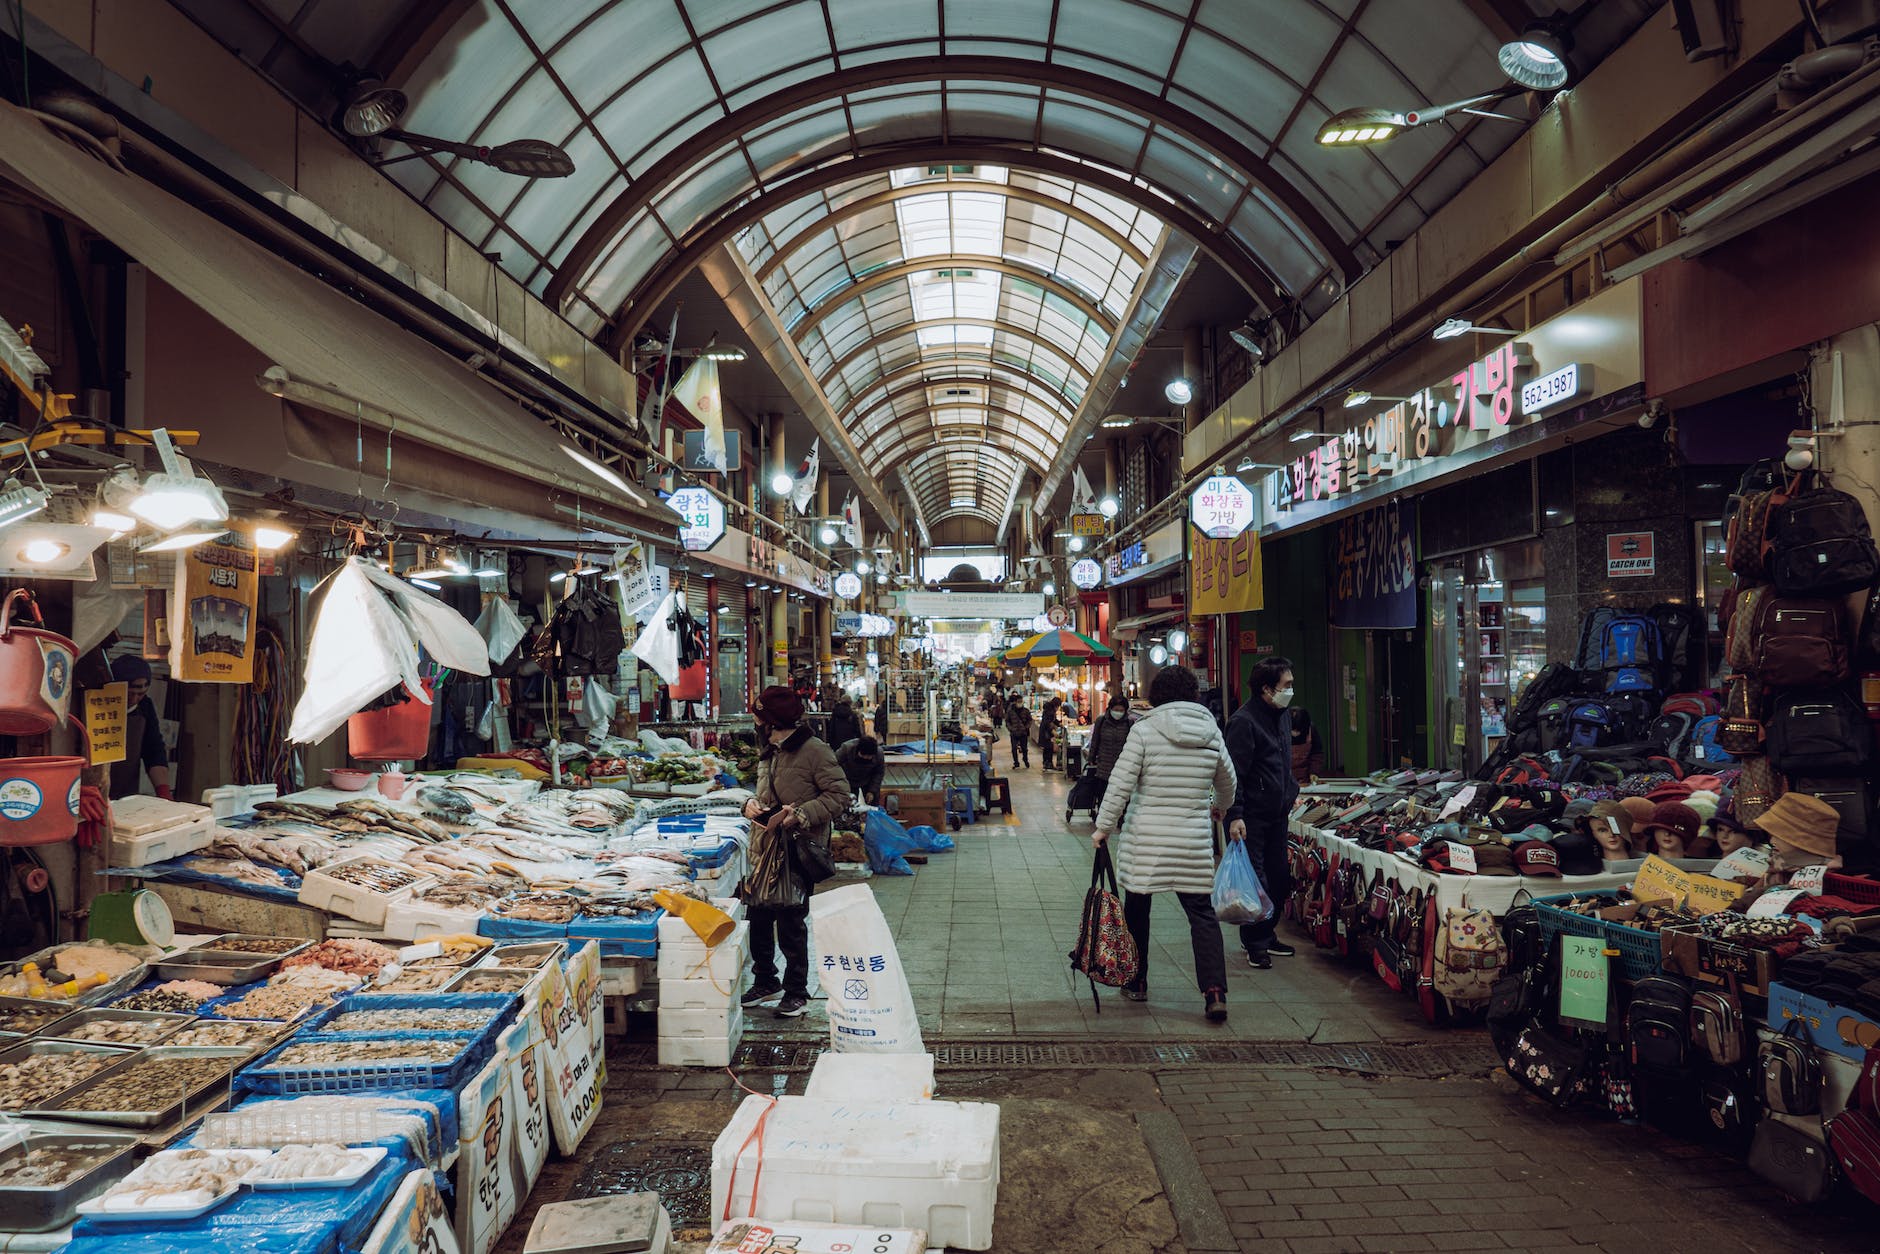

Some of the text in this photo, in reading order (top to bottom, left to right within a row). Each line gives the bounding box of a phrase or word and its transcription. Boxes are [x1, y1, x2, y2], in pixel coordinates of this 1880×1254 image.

[1453, 342, 1518, 431] 가방
[1524, 371, 1574, 407] 562-1987
[1208, 481, 1238, 494] 미소
[676, 493, 709, 511] 광천
[1201, 495, 1243, 508] 화장품
[679, 513, 709, 528] 회
[1210, 511, 1236, 525] 가방
[1610, 559, 1653, 569] CATCH ONE
[209, 567, 237, 586] 사용처
[1573, 944, 1599, 958] 가방
